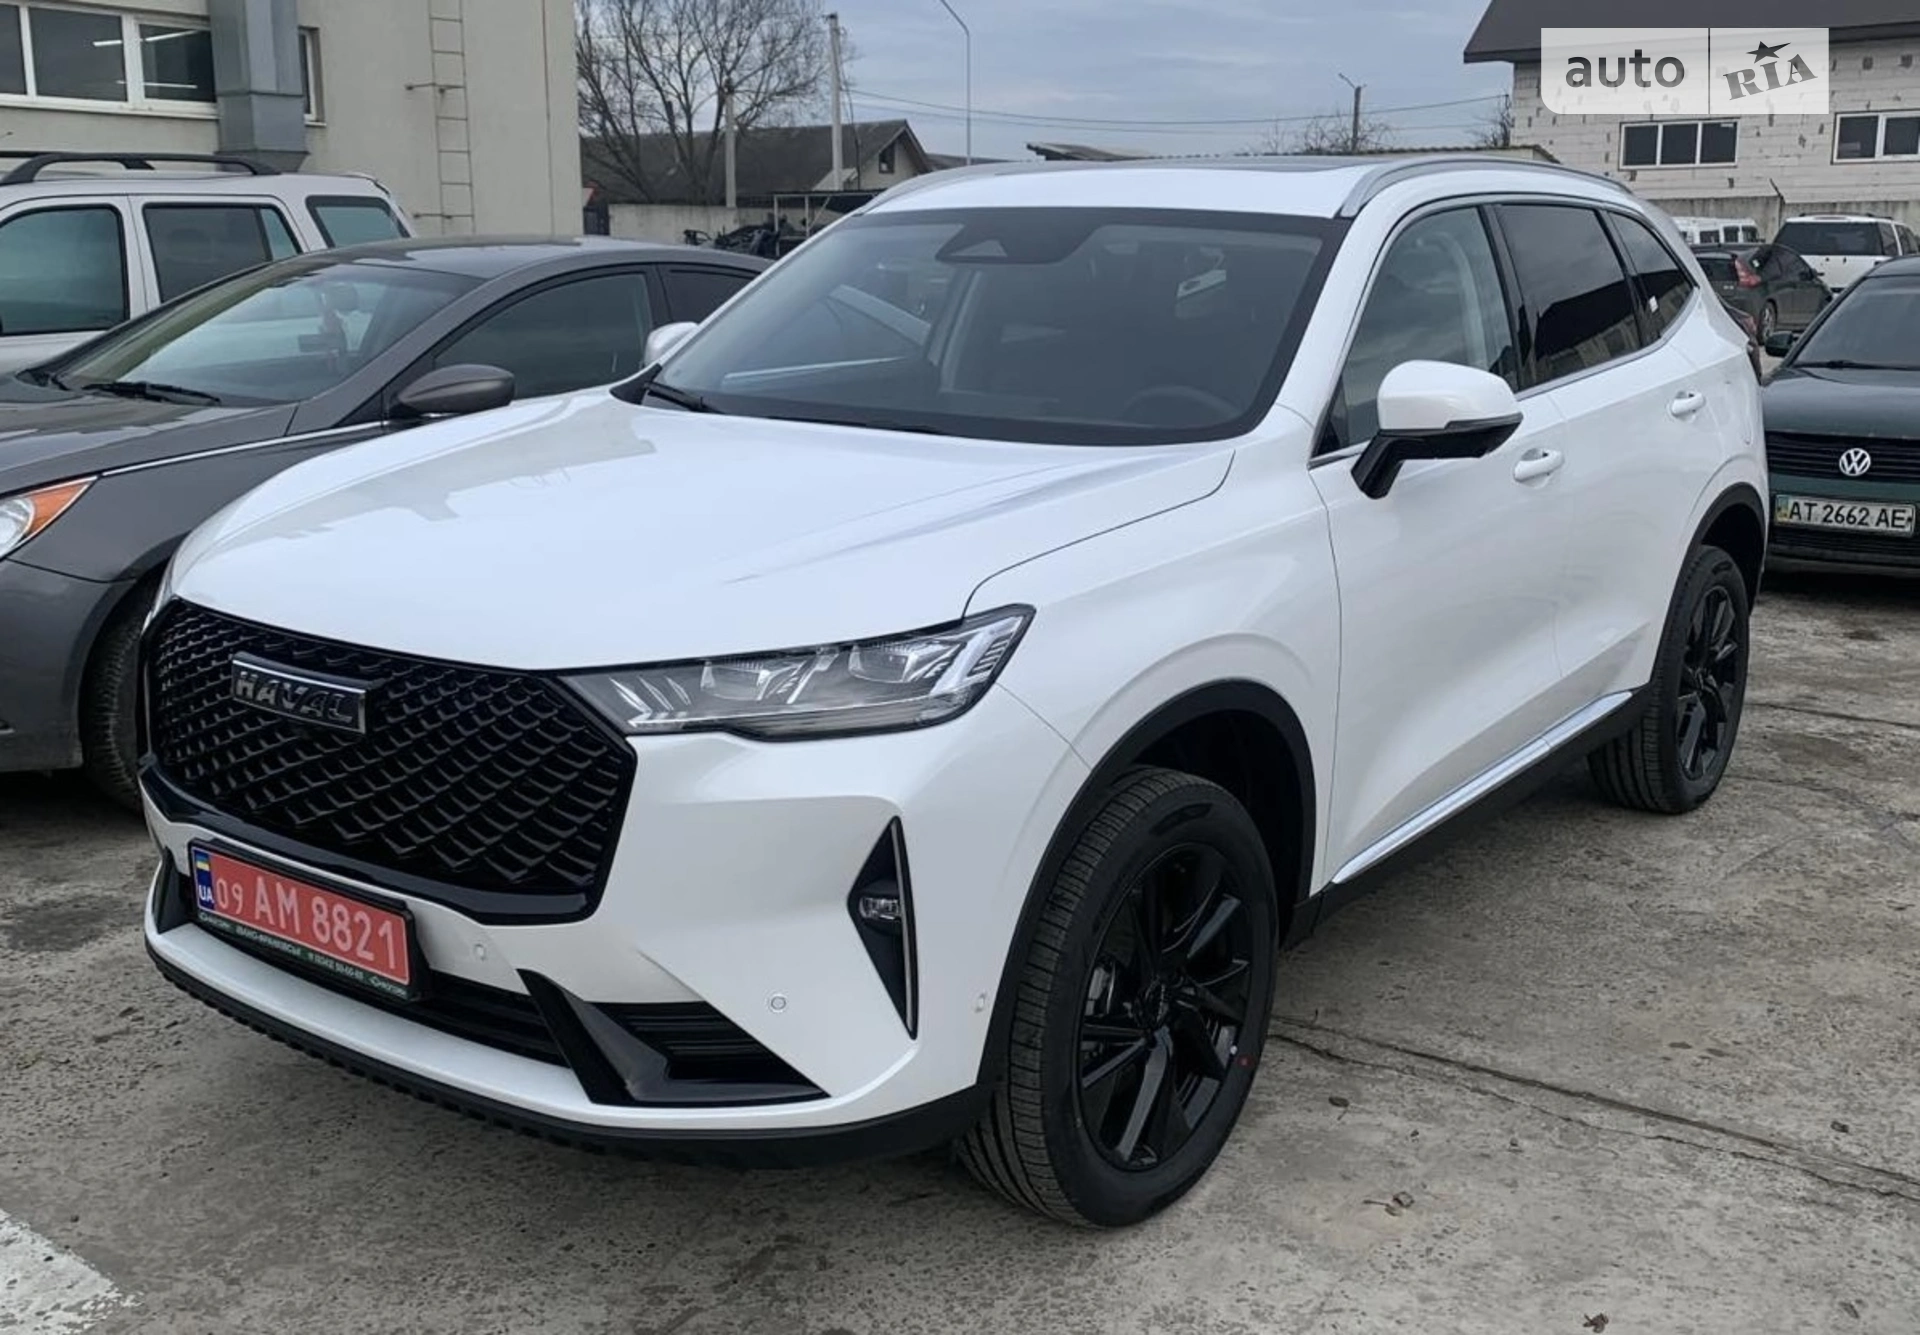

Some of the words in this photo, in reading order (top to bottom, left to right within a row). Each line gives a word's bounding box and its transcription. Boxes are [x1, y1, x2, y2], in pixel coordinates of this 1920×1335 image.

[1789, 501, 1818, 520] AT
[1822, 503, 1871, 527] 2662
[1874, 508, 1908, 529] AE
[235, 670, 353, 723] HAVAL
[198, 884, 215, 904] UA
[215, 877, 244, 916] 09
[254, 875, 301, 935] AM
[310, 895, 397, 970] 8821
